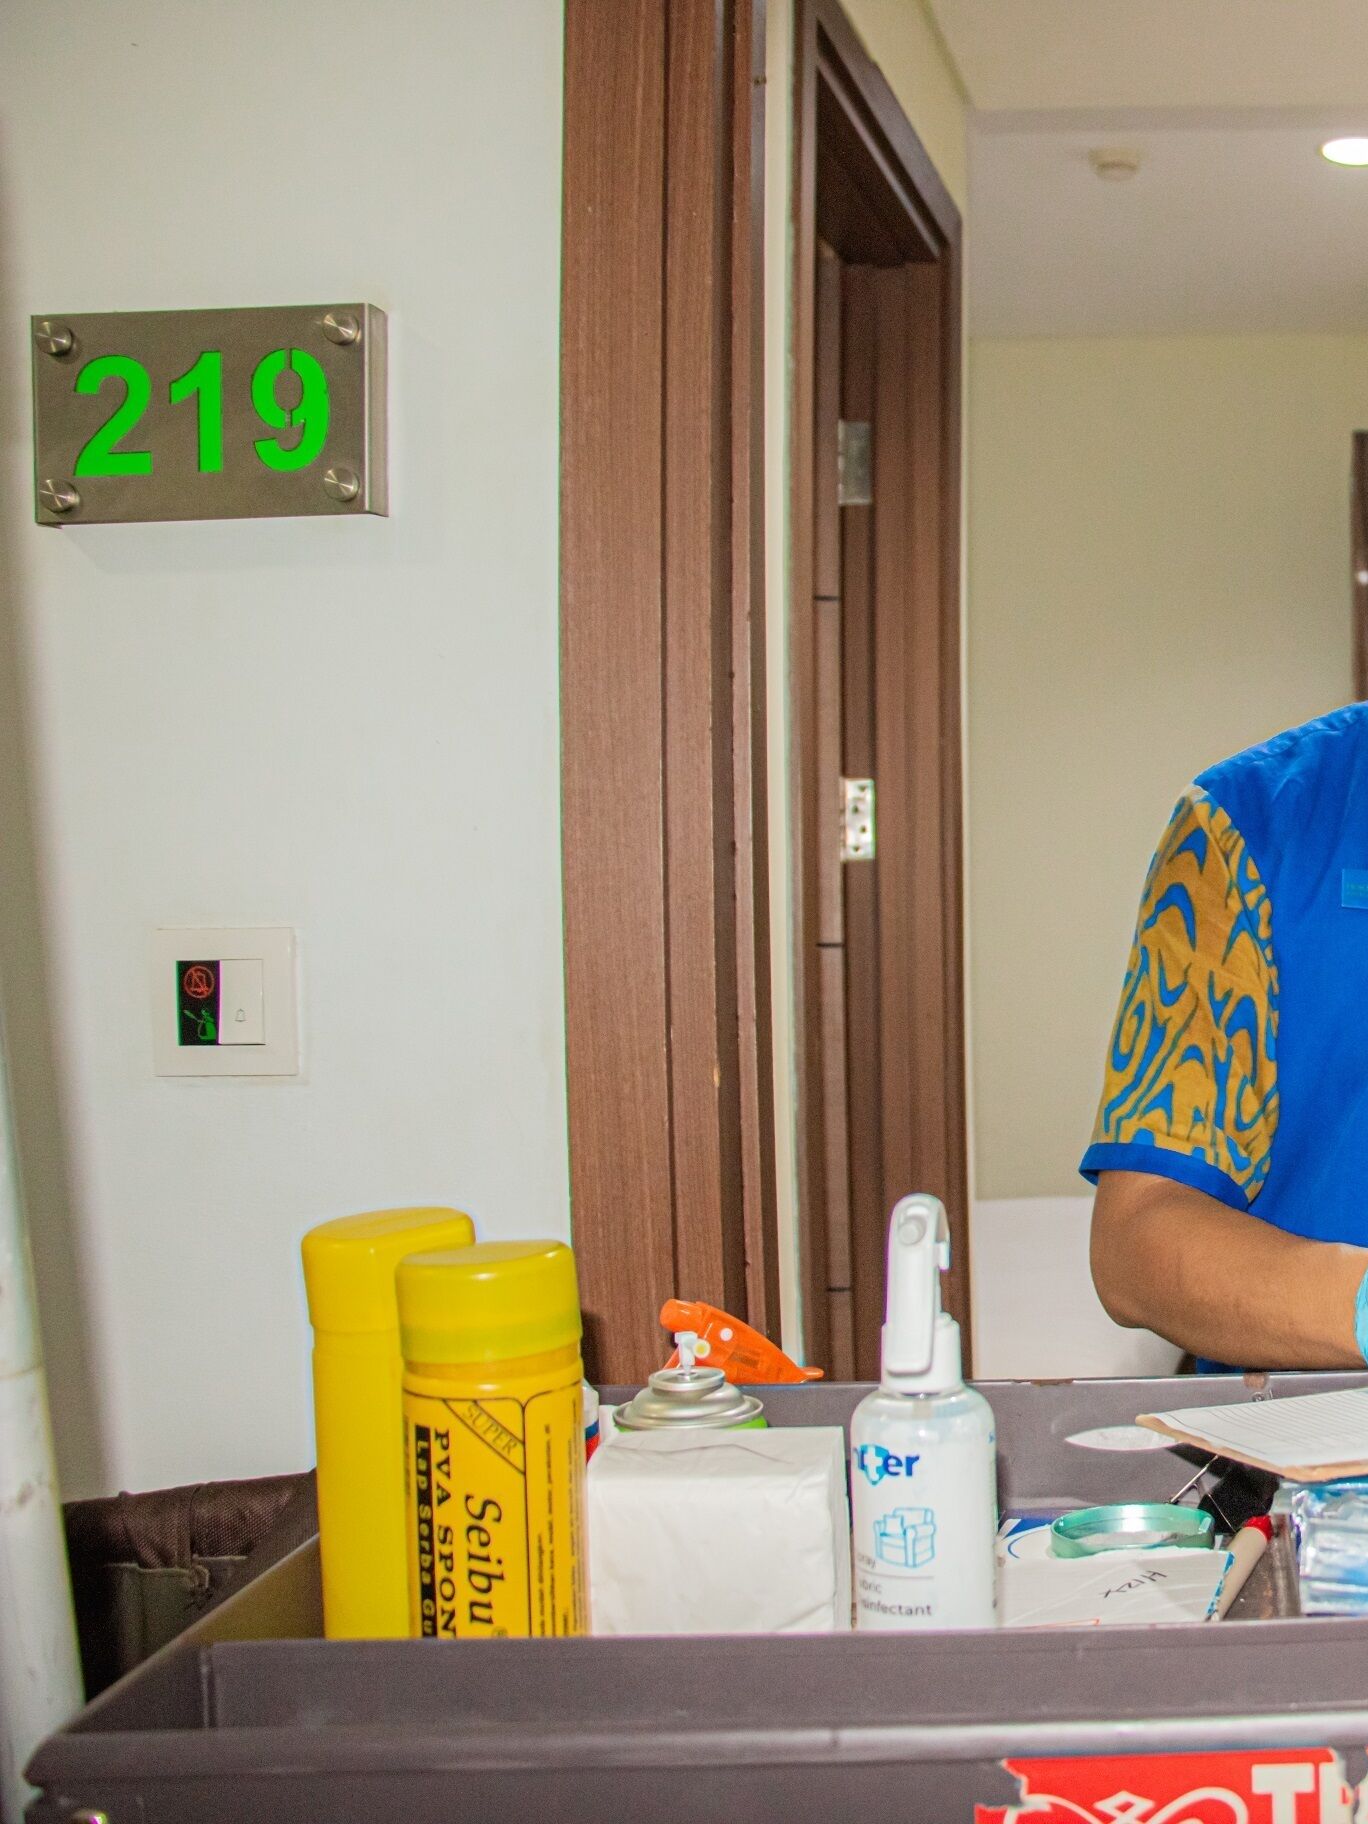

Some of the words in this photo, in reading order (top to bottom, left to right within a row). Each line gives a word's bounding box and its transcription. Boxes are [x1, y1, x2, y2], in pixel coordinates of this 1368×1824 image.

[73, 347, 330, 477] 219
[416, 1439, 431, 1492] Lap
[433, 1428, 453, 1507] PVA
[465, 1404, 518, 1456] SUPER
[418, 1503, 434, 1585] Serba
[463, 1494, 507, 1626] Seibu
